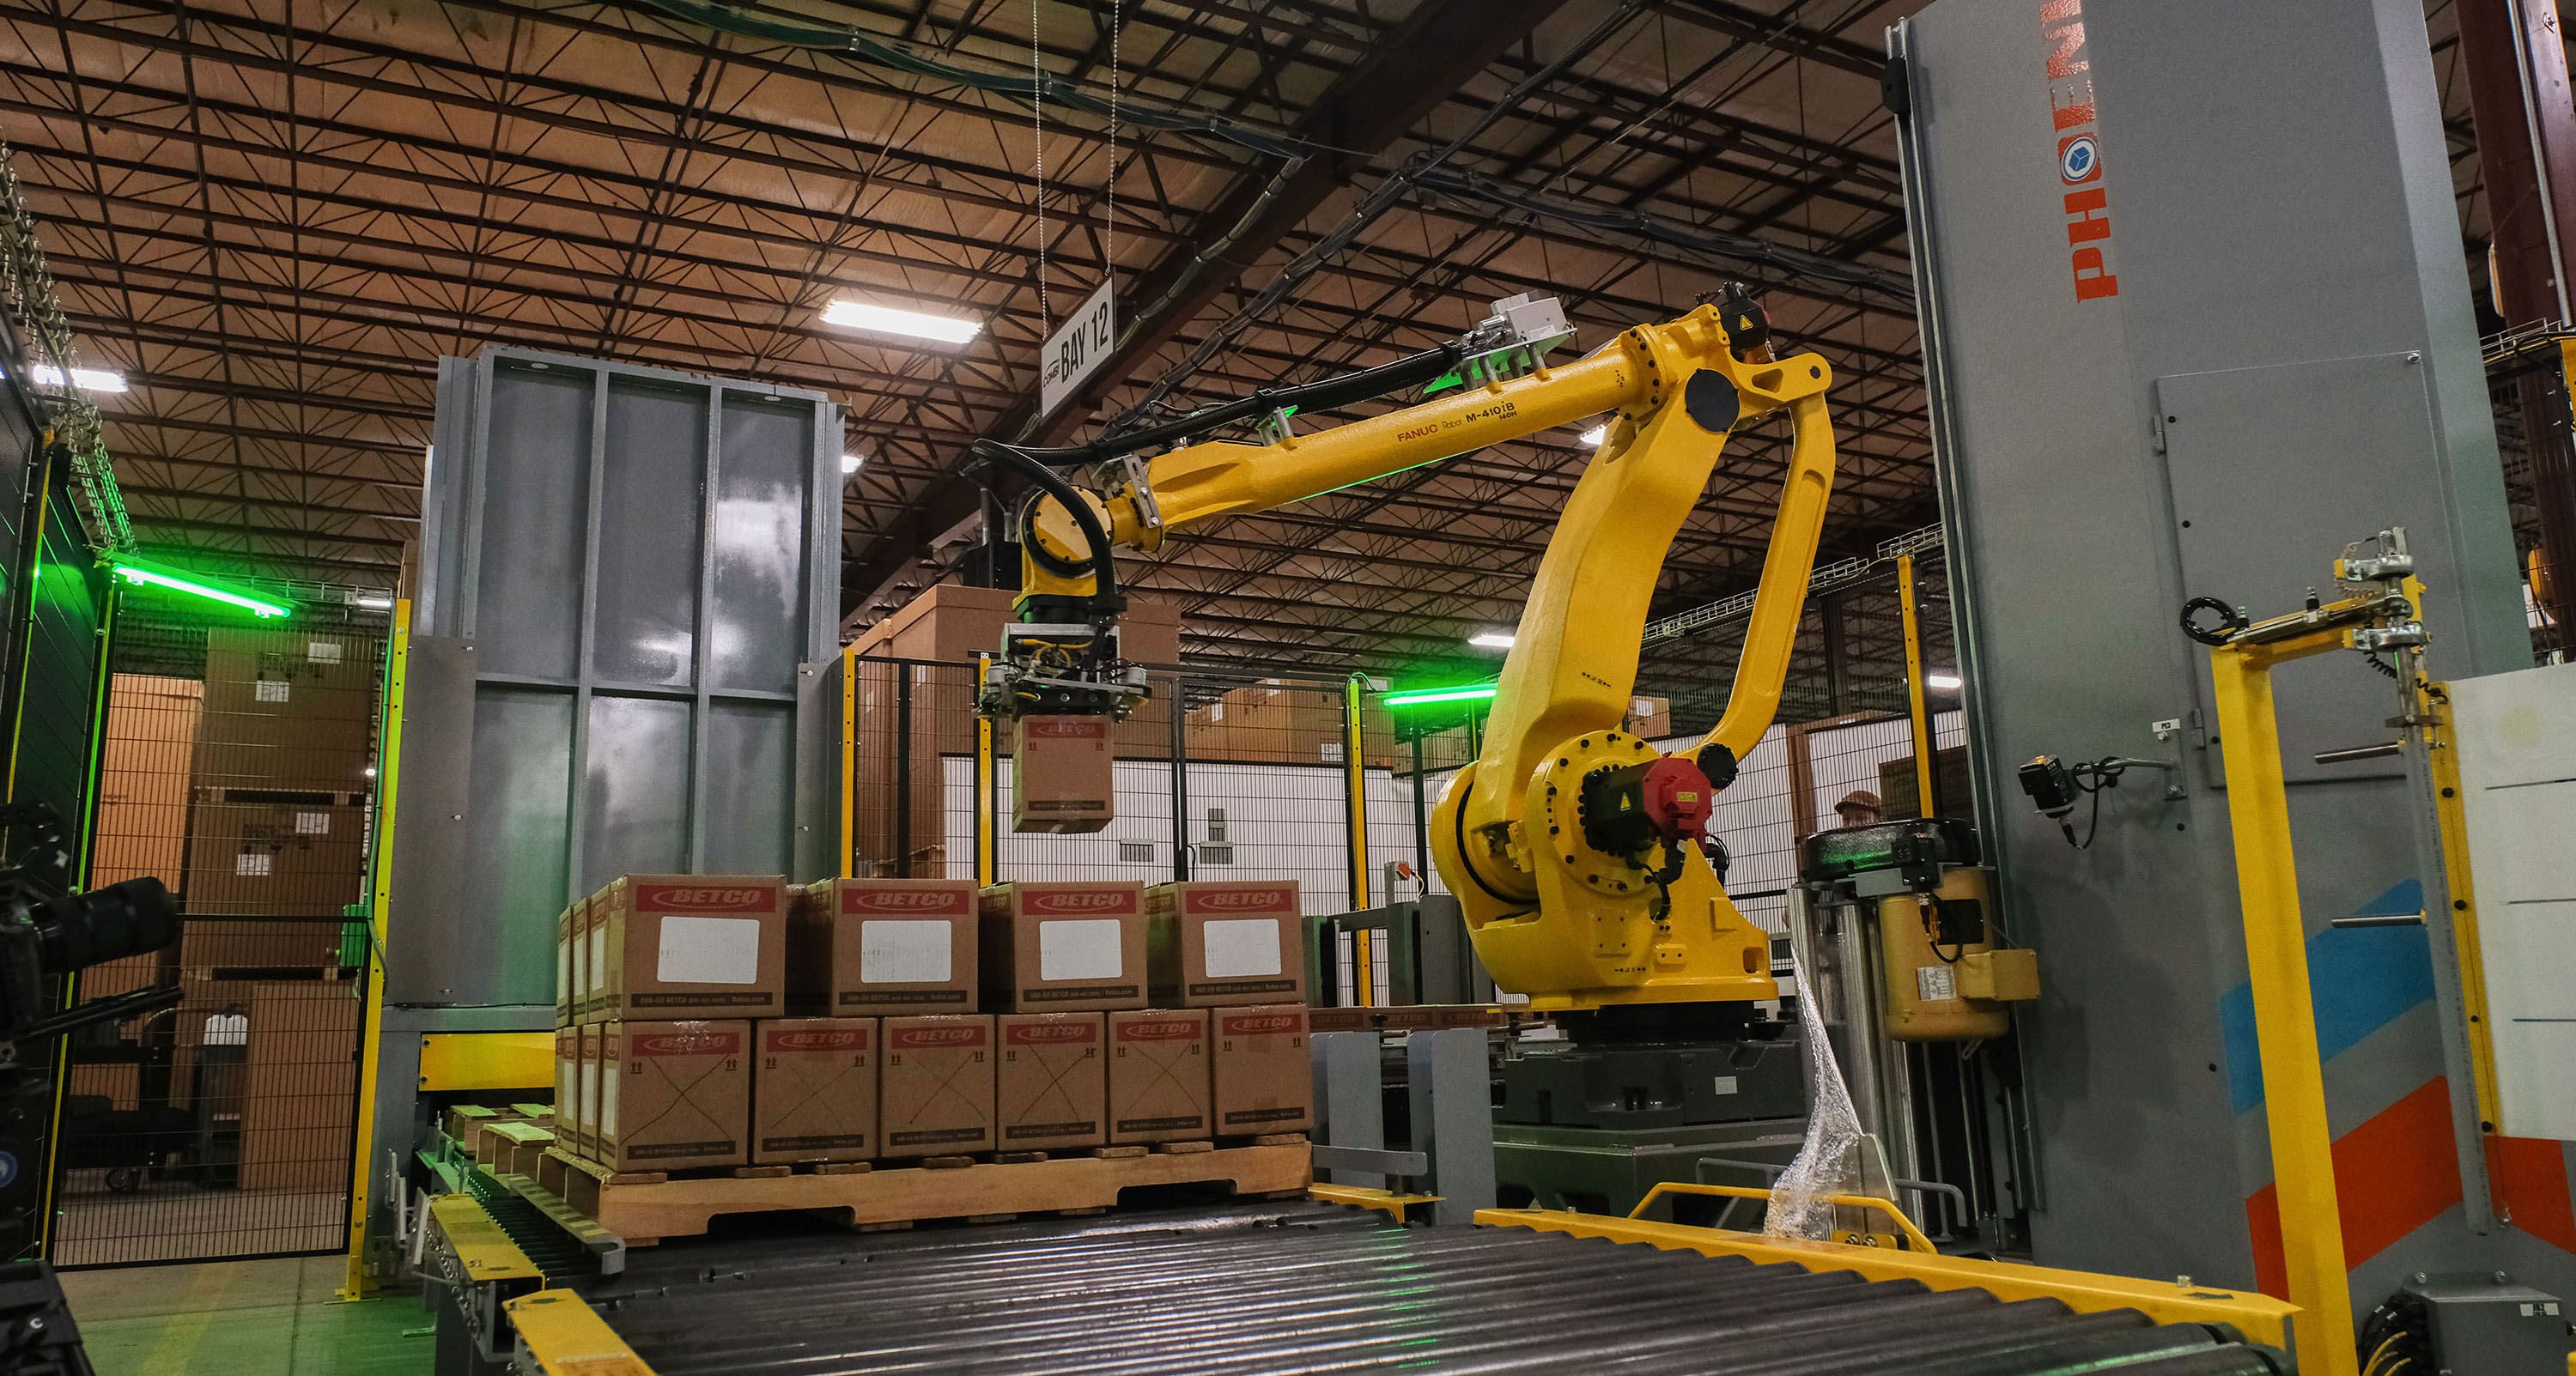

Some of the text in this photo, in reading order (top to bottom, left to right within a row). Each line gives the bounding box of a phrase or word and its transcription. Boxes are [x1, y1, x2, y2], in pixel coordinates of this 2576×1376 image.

[1061, 301, 1109, 385] BAY 12
[1499, 410, 1517, 420] 140H
[1398, 401, 1516, 442] FANUC Robot M-410iB
[672, 889, 762, 903] BETCO
[874, 893, 956, 906] BETCO
[1051, 894, 1124, 906] BETCO
[1212, 892, 1280, 905] BETCO
[1138, 1022, 1192, 1034] BETCO
[1242, 1016, 1292, 1028] BETCO
[915, 1029, 975, 1041] BETCO
[1029, 1027, 1085, 1038] BETCO
[659, 1036, 727, 1048] BCO
[792, 1033, 856, 1045] BETCO
